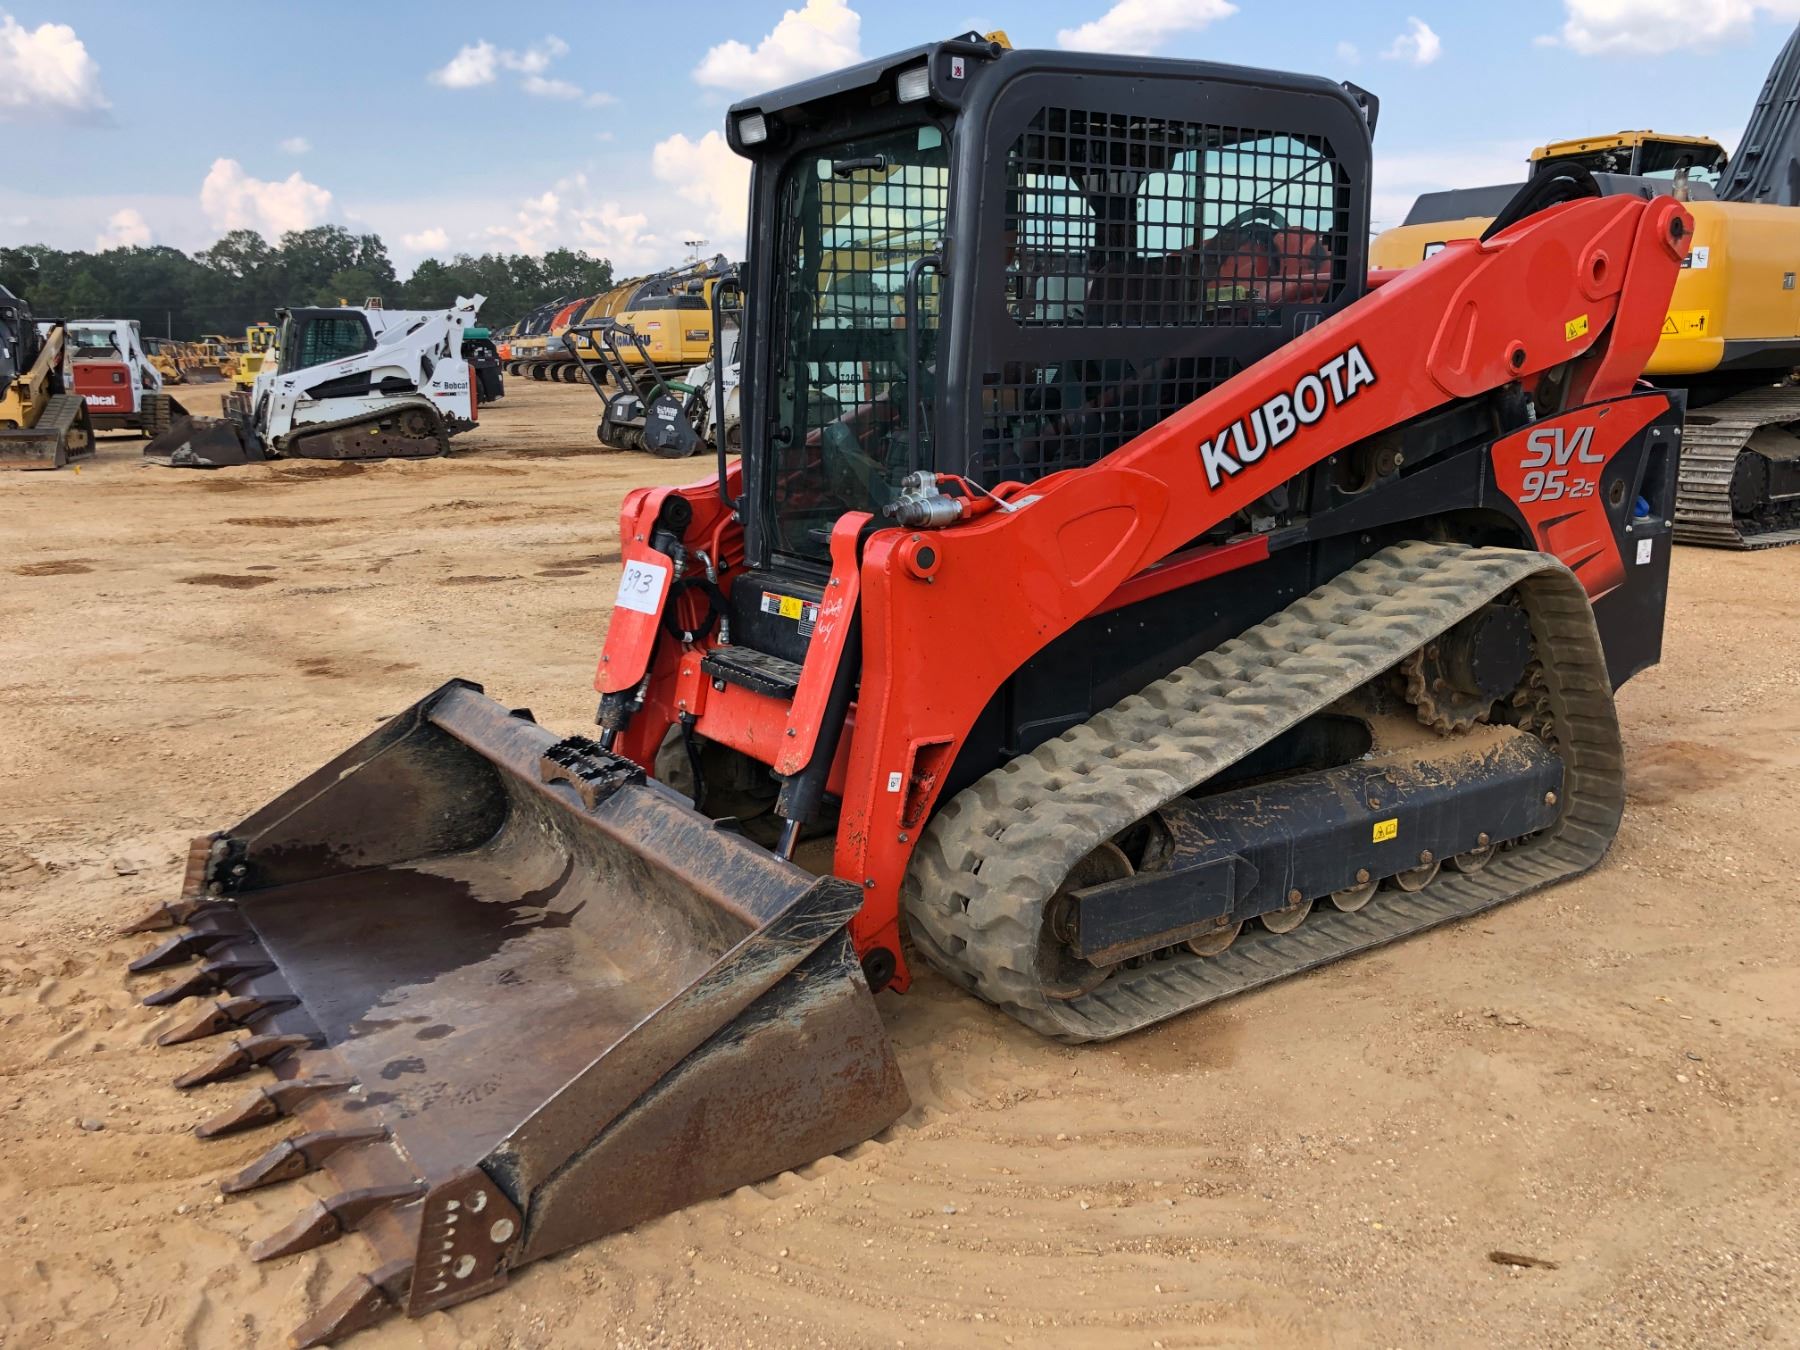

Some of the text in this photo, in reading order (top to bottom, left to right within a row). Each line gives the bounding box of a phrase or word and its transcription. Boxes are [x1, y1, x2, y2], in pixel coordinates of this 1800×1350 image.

[443, 381, 468, 390] Bobcat
[84, 394, 116, 406] obcat
[1199, 345, 1376, 488] KUBOTA
[1519, 426, 1605, 468] SVL
